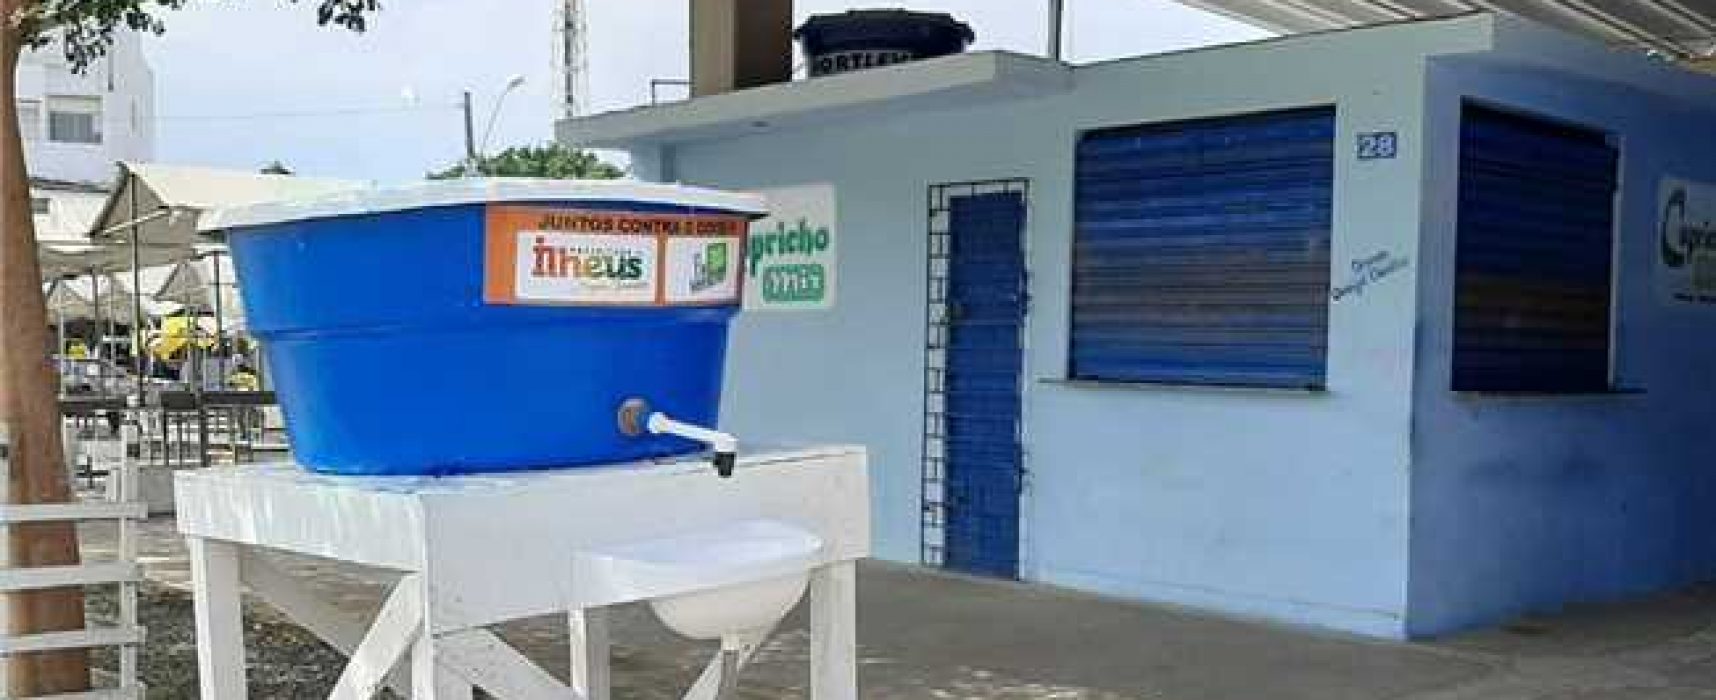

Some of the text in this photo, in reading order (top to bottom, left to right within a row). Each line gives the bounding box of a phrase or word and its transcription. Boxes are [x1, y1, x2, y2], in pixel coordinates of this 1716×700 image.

[1359, 134, 1396, 157] 28
[538, 213, 613, 232] JUNTOS
[749, 217, 829, 277] pricho
